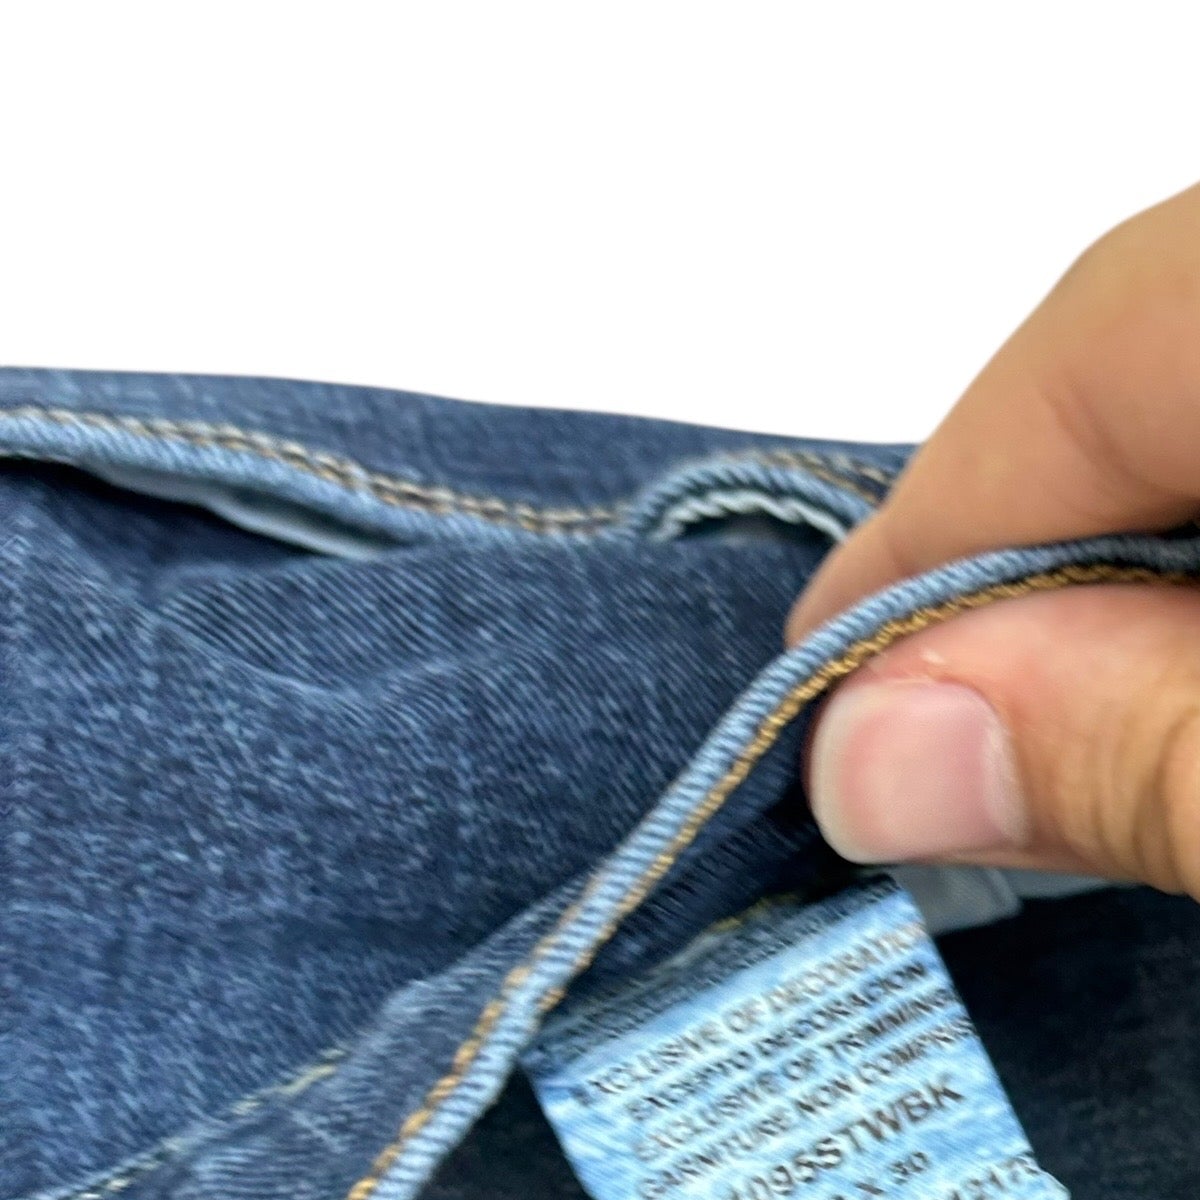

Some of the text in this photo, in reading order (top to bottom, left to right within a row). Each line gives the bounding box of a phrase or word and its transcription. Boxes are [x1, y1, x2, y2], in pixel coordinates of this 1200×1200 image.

[722, 998, 766, 1034] OF
[634, 1072, 778, 1162] EXCLUSIVE
[780, 1048, 817, 1082] OF
[796, 1072, 856, 1114] NON
